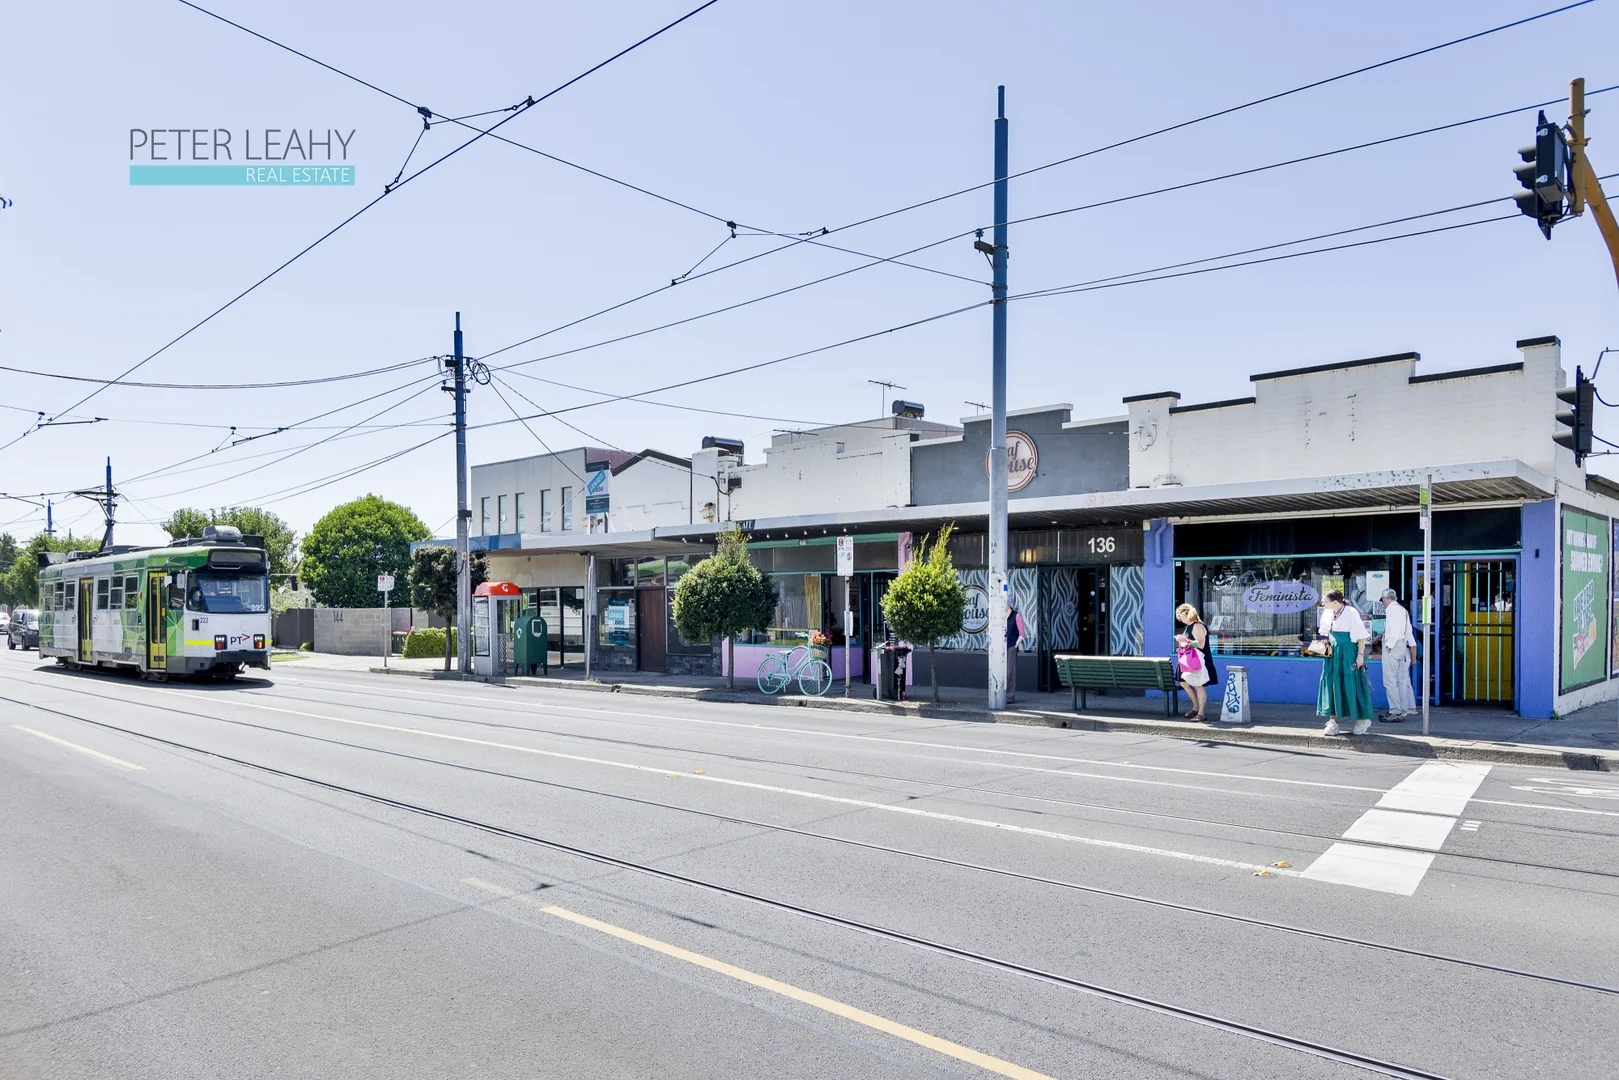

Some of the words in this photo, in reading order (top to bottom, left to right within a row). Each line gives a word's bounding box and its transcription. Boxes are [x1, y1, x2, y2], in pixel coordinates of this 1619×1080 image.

[1007, 441, 1021, 461] af
[1007, 457, 1035, 473] use
[1088, 536, 1115, 553] 136
[1248, 585, 1314, 602] Feminista
[250, 604, 265, 612] 222
[963, 607, 989, 619] ous
[333, 611, 343, 623] 144
